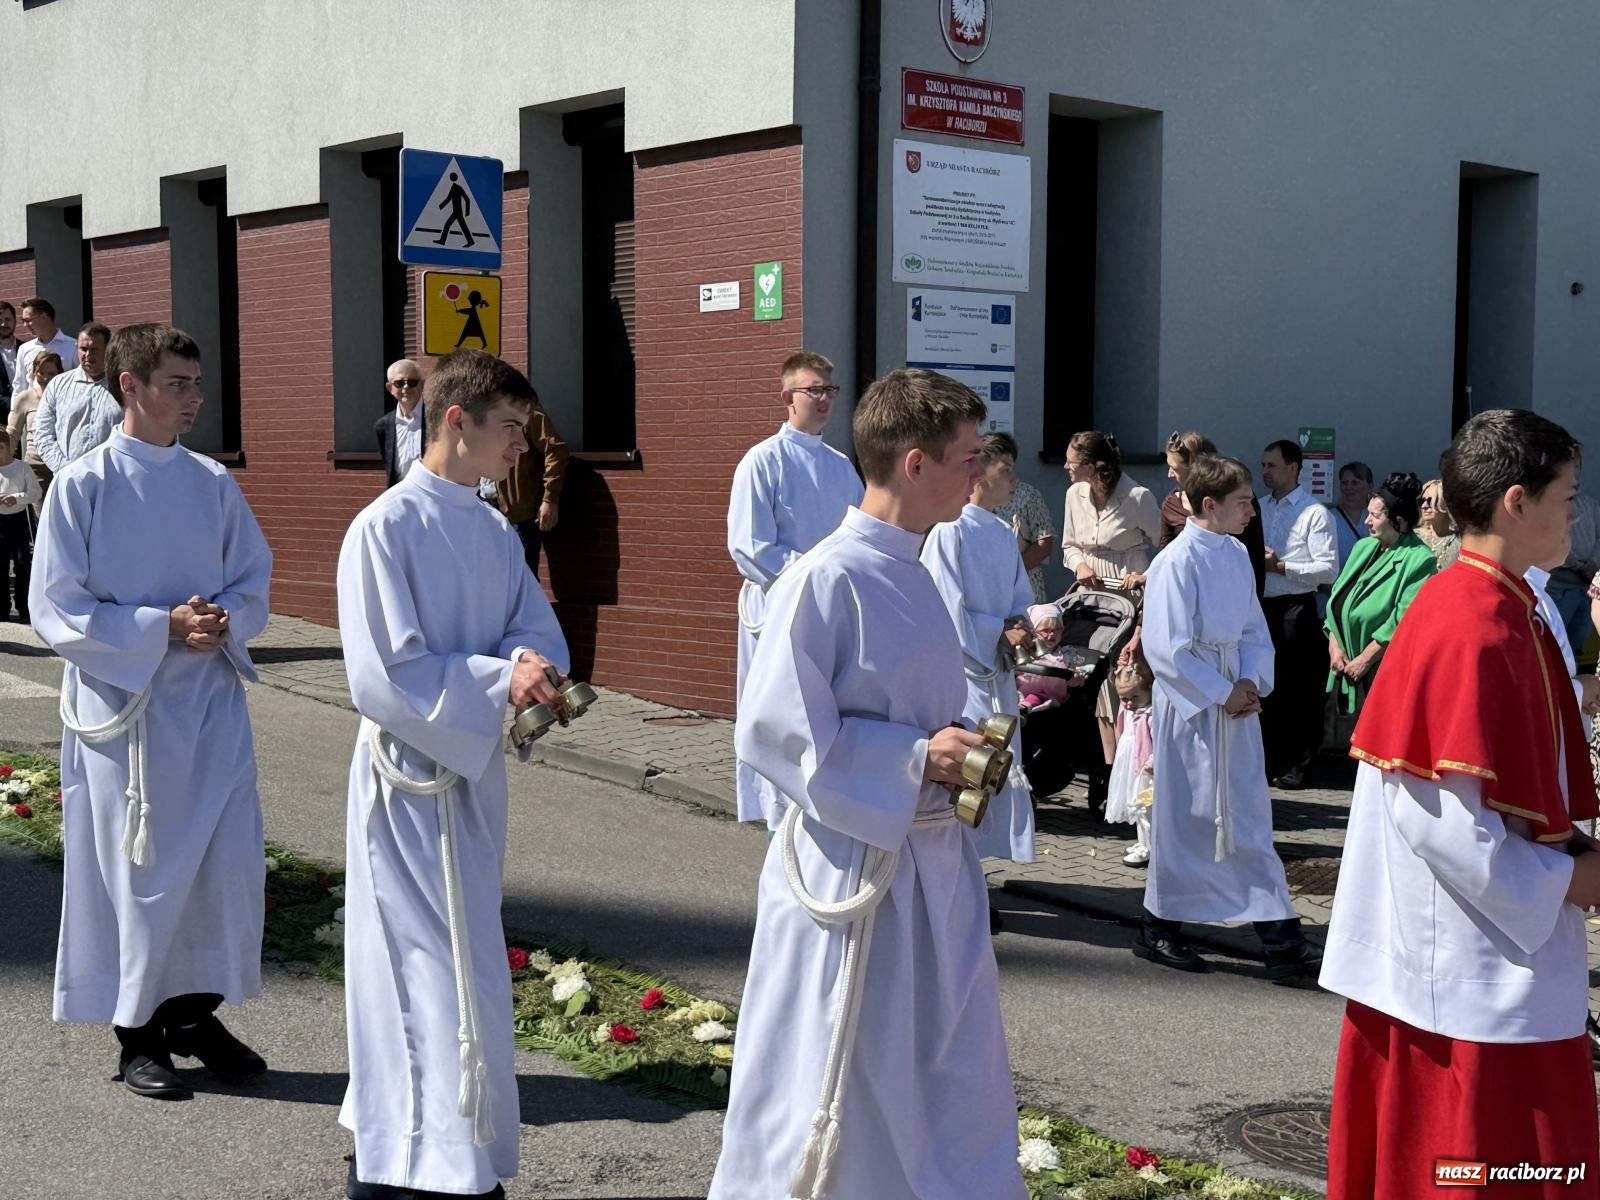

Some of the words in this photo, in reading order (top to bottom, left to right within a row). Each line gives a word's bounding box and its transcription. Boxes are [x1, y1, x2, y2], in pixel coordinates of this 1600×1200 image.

[925, 79, 949, 94] SZKOŁA
[951, 83, 992, 101] PODSTAWOWA
[993, 91, 1002, 102] NR
[907, 93, 917, 106] IM.
[919, 95, 958, 111] KRZYSZTOFA
[959, 101, 981, 116] KAMILA
[982, 103, 1023, 123] BACZYŃSKIEGO
[946, 116, 954, 128] W
[954, 117, 987, 133] RACIBORZU
[948, 163, 971, 173] MIASTA
[759, 297, 776, 308] AED
